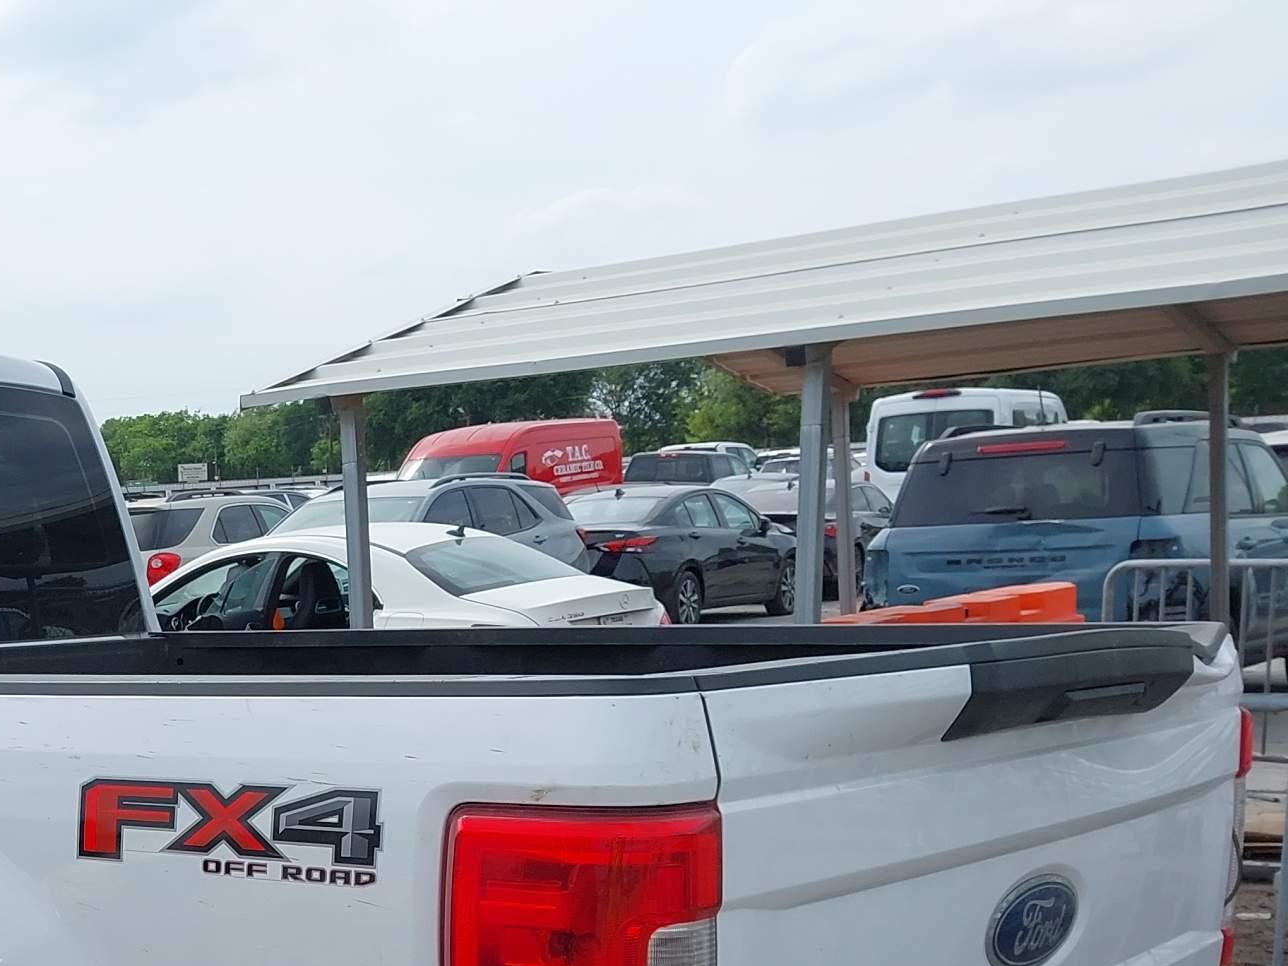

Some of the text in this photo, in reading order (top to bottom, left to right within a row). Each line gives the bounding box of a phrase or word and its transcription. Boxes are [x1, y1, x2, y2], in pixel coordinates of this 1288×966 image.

[77, 777, 383, 864] FX4
[203, 858, 377, 887] OFF ROAD
[1014, 896, 1067, 956] Ford
